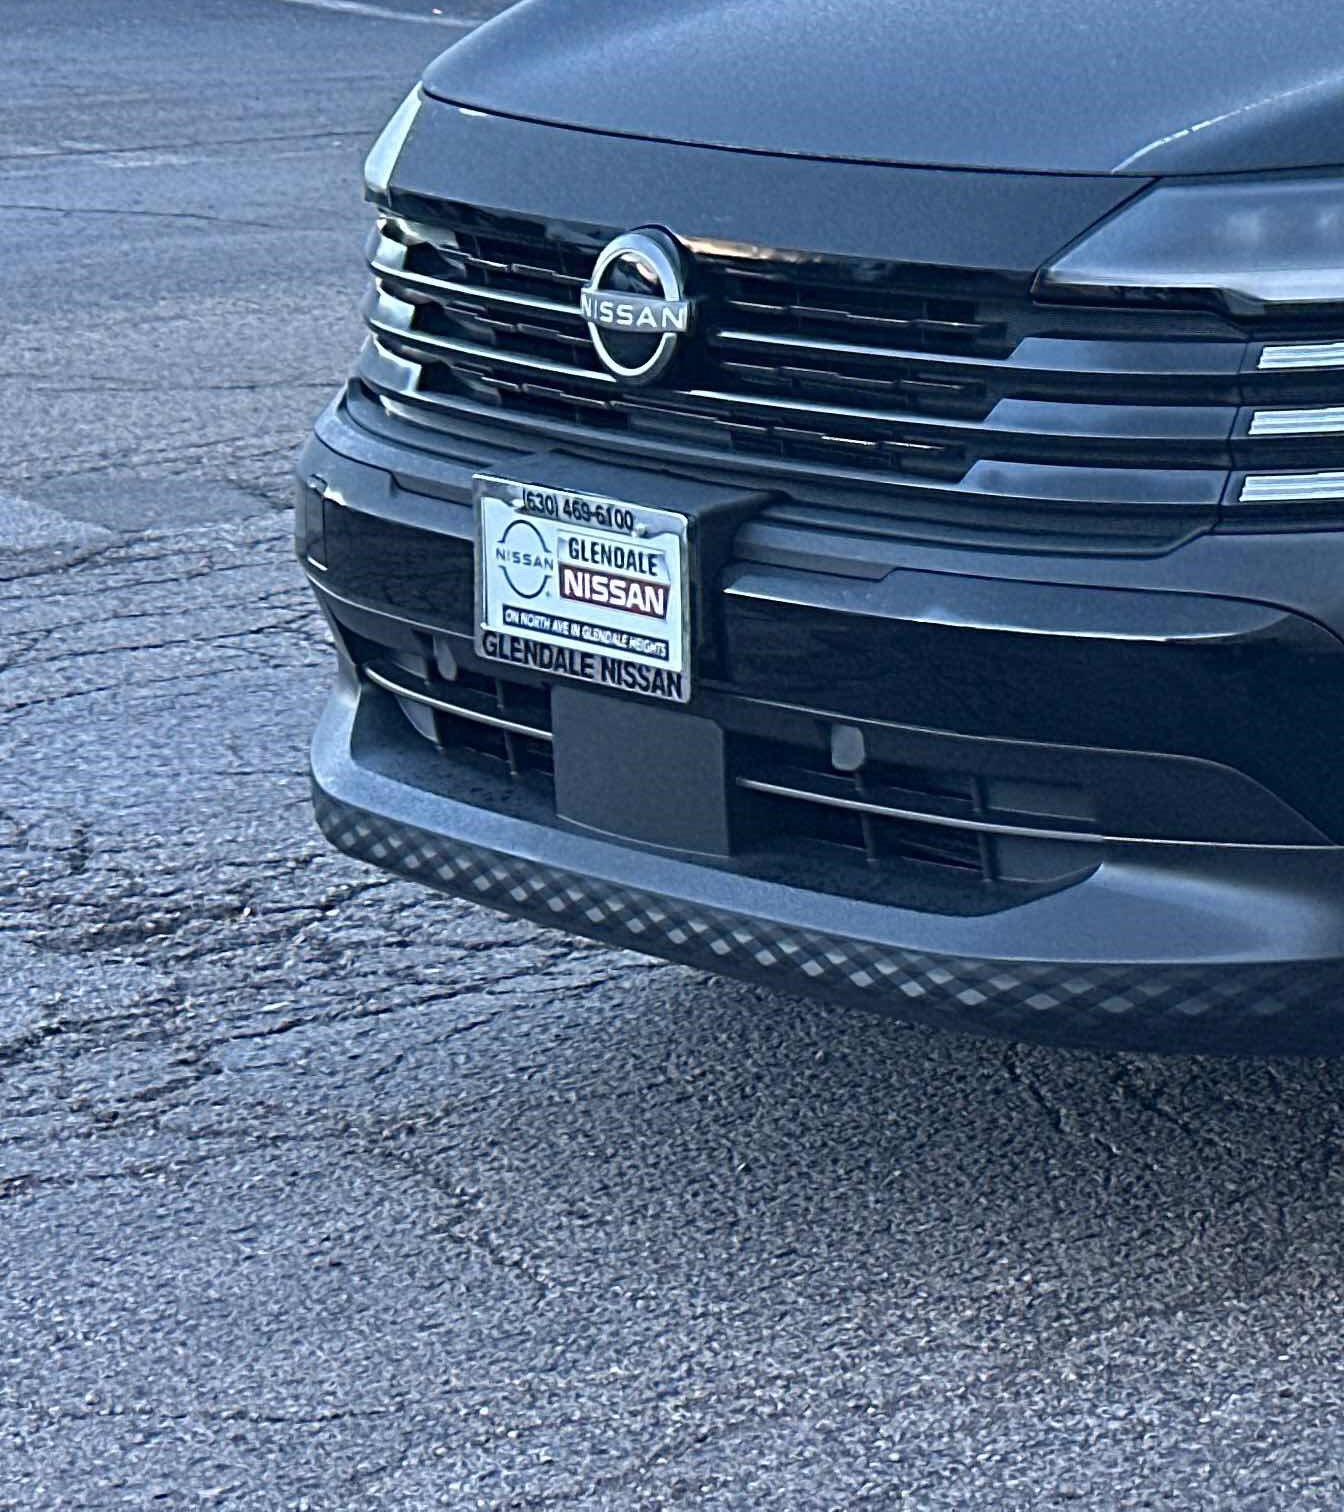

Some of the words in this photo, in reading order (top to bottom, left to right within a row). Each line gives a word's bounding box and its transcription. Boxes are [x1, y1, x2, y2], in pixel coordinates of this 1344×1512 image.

[581, 293, 685, 329] NISSAN
[522, 488, 559, 518] (630)
[562, 498, 634, 531] 469-6100
[496, 547, 554, 571] NISSAN
[568, 537, 659, 576] GLENDALE
[563, 569, 664, 616] NISSAN
[504, 609, 520, 624] ON
[520, 612, 551, 629] NORTH
[551, 618, 570, 636] AVE
[570, 622, 581, 637] IN
[482, 631, 595, 679] GLENDALE
[601, 660, 682, 699] NISSAN
